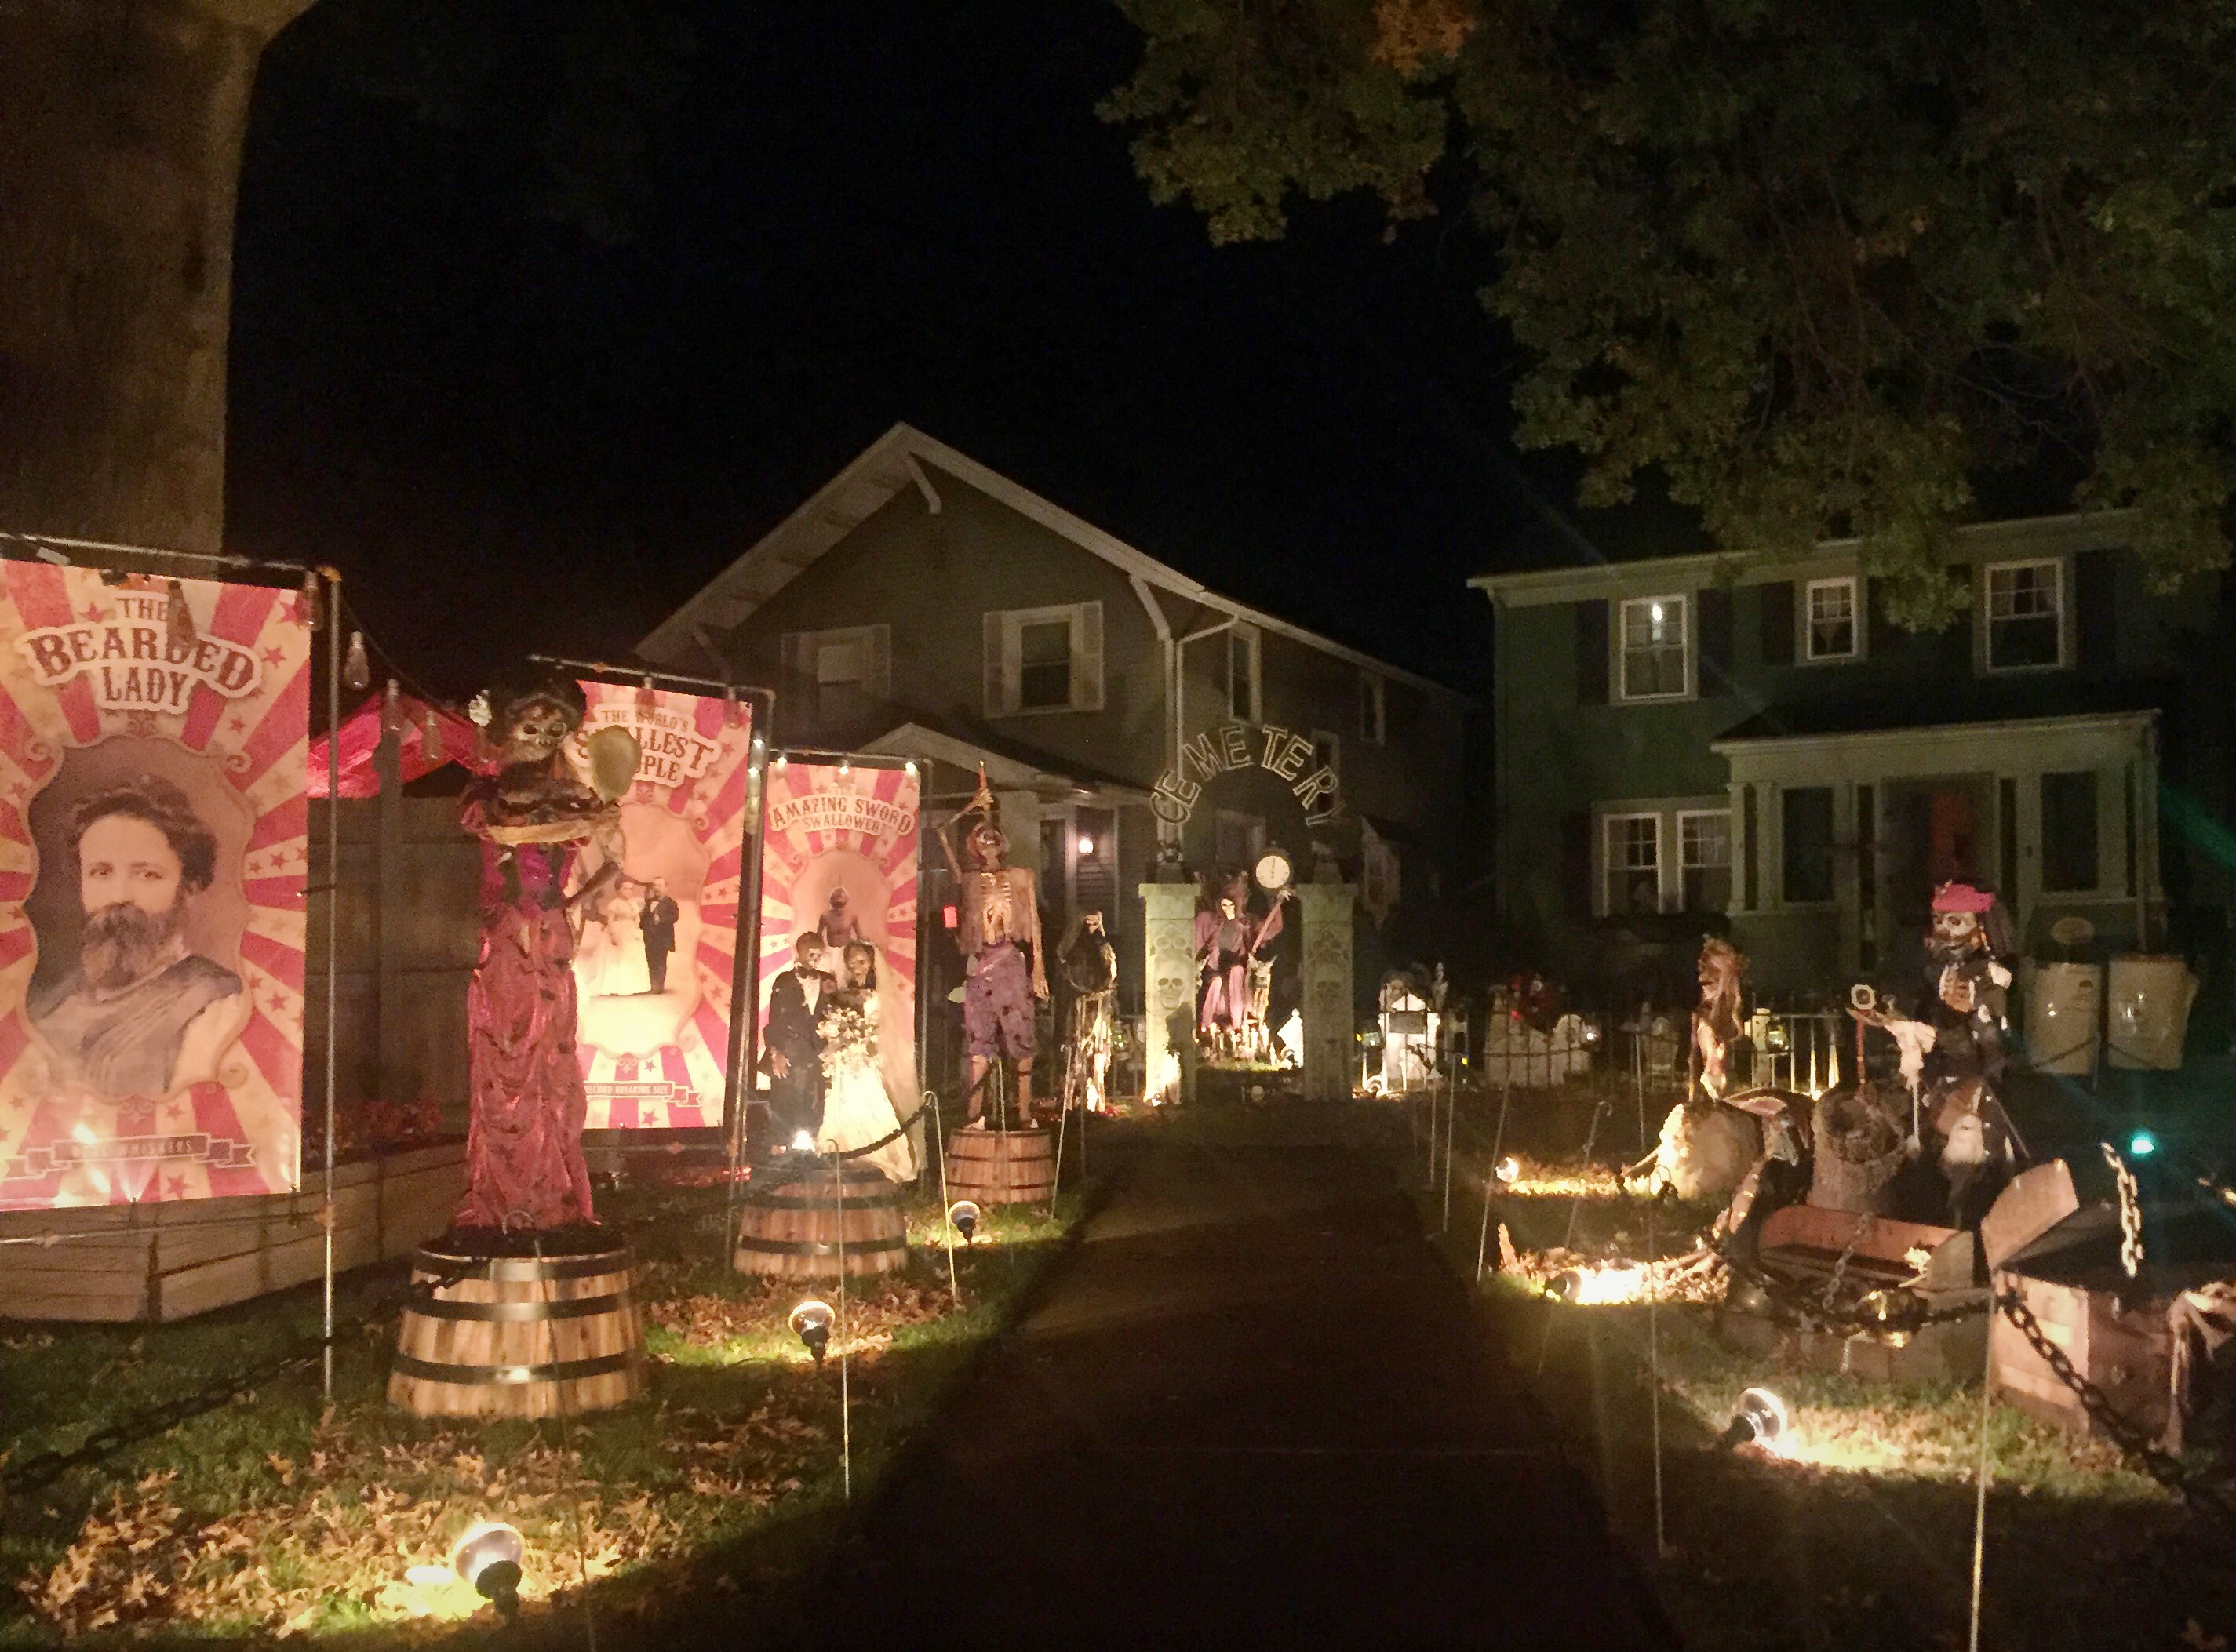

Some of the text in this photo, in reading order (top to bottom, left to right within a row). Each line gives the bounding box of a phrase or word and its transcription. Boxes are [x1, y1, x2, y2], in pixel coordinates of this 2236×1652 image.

[115, 596, 168, 622] THE
[27, 627, 253, 691] BEARDED
[100, 665, 189, 707] LADY
[602, 709, 629, 723] THE
[574, 726, 715, 770] SLLEST
[772, 796, 913, 833] AMAZING SWORD
[803, 813, 880, 832] SWALLOWER
